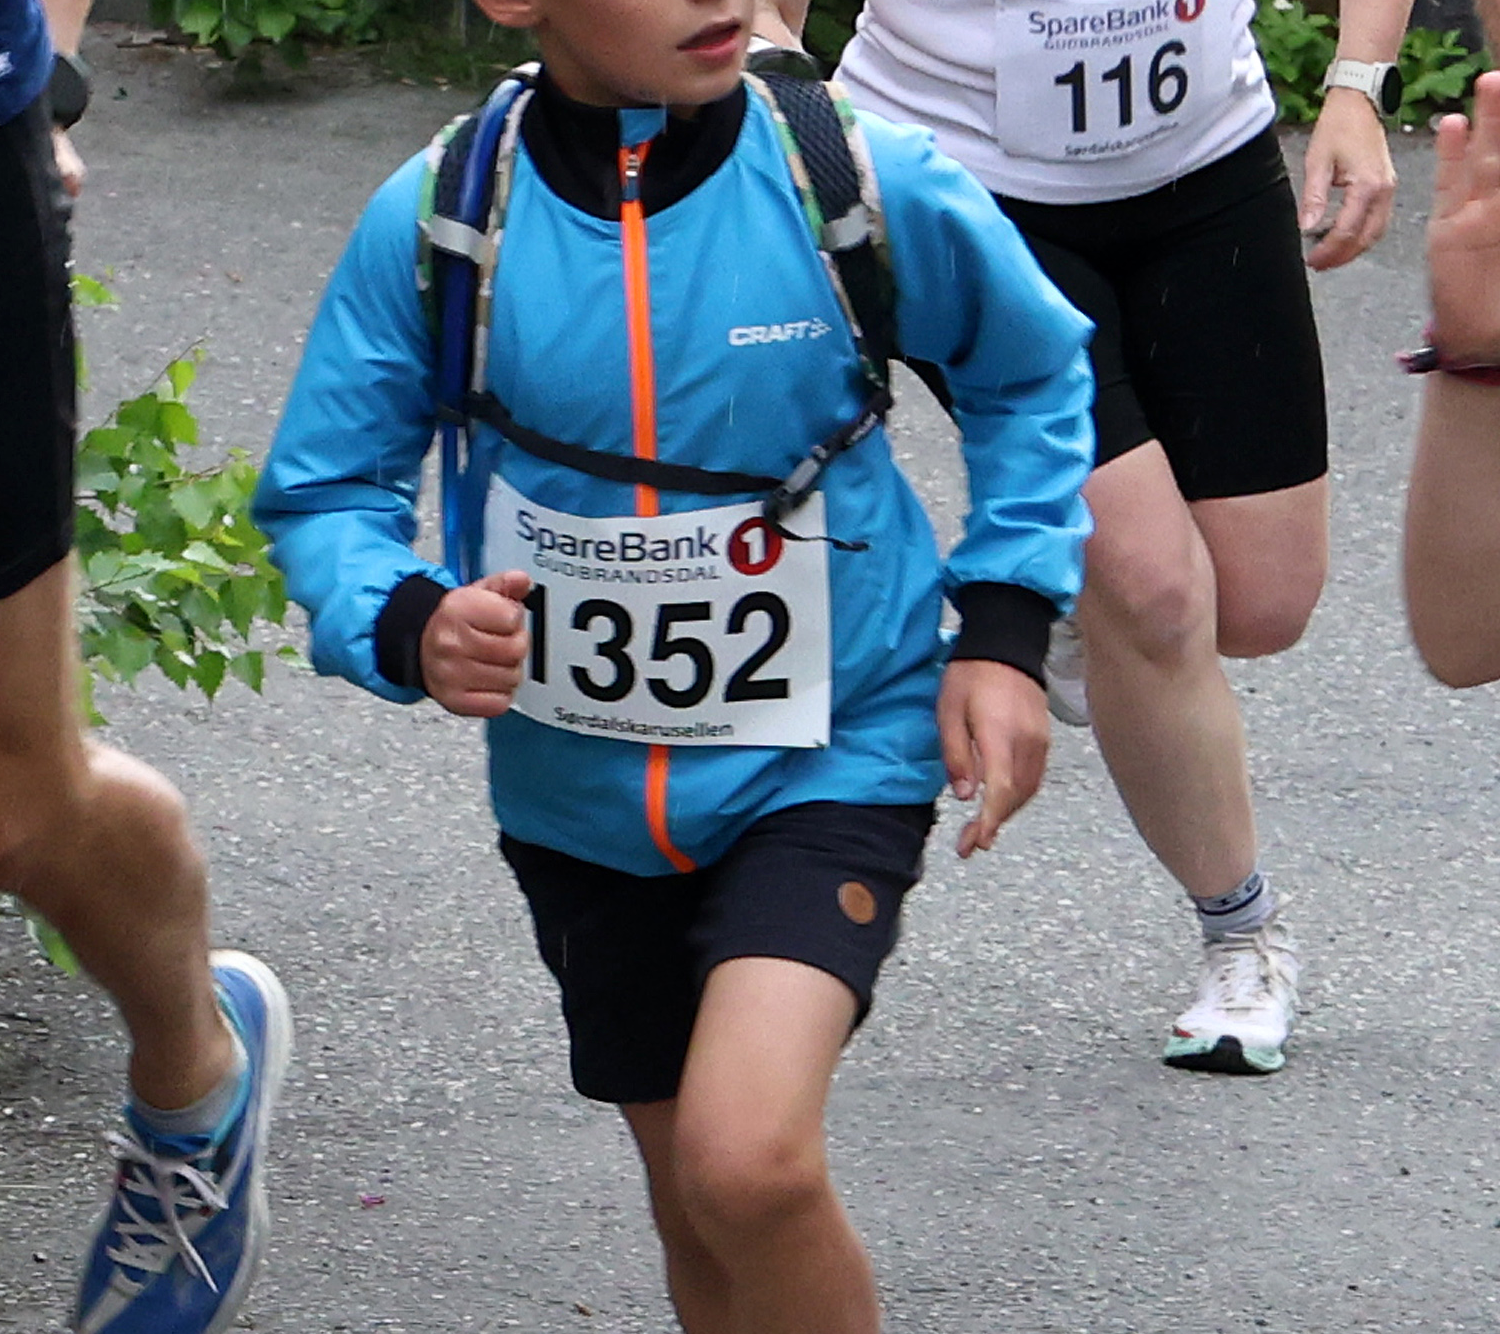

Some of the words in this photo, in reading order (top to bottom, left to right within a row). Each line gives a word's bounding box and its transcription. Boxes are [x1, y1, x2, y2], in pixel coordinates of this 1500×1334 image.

[1054, 40, 1189, 133] 116
[728, 321, 810, 346] CRAFT
[516, 510, 719, 563] SpareBank
[533, 553, 722, 584] GUDBRANDSDAL
[523, 583, 791, 708] 1352
